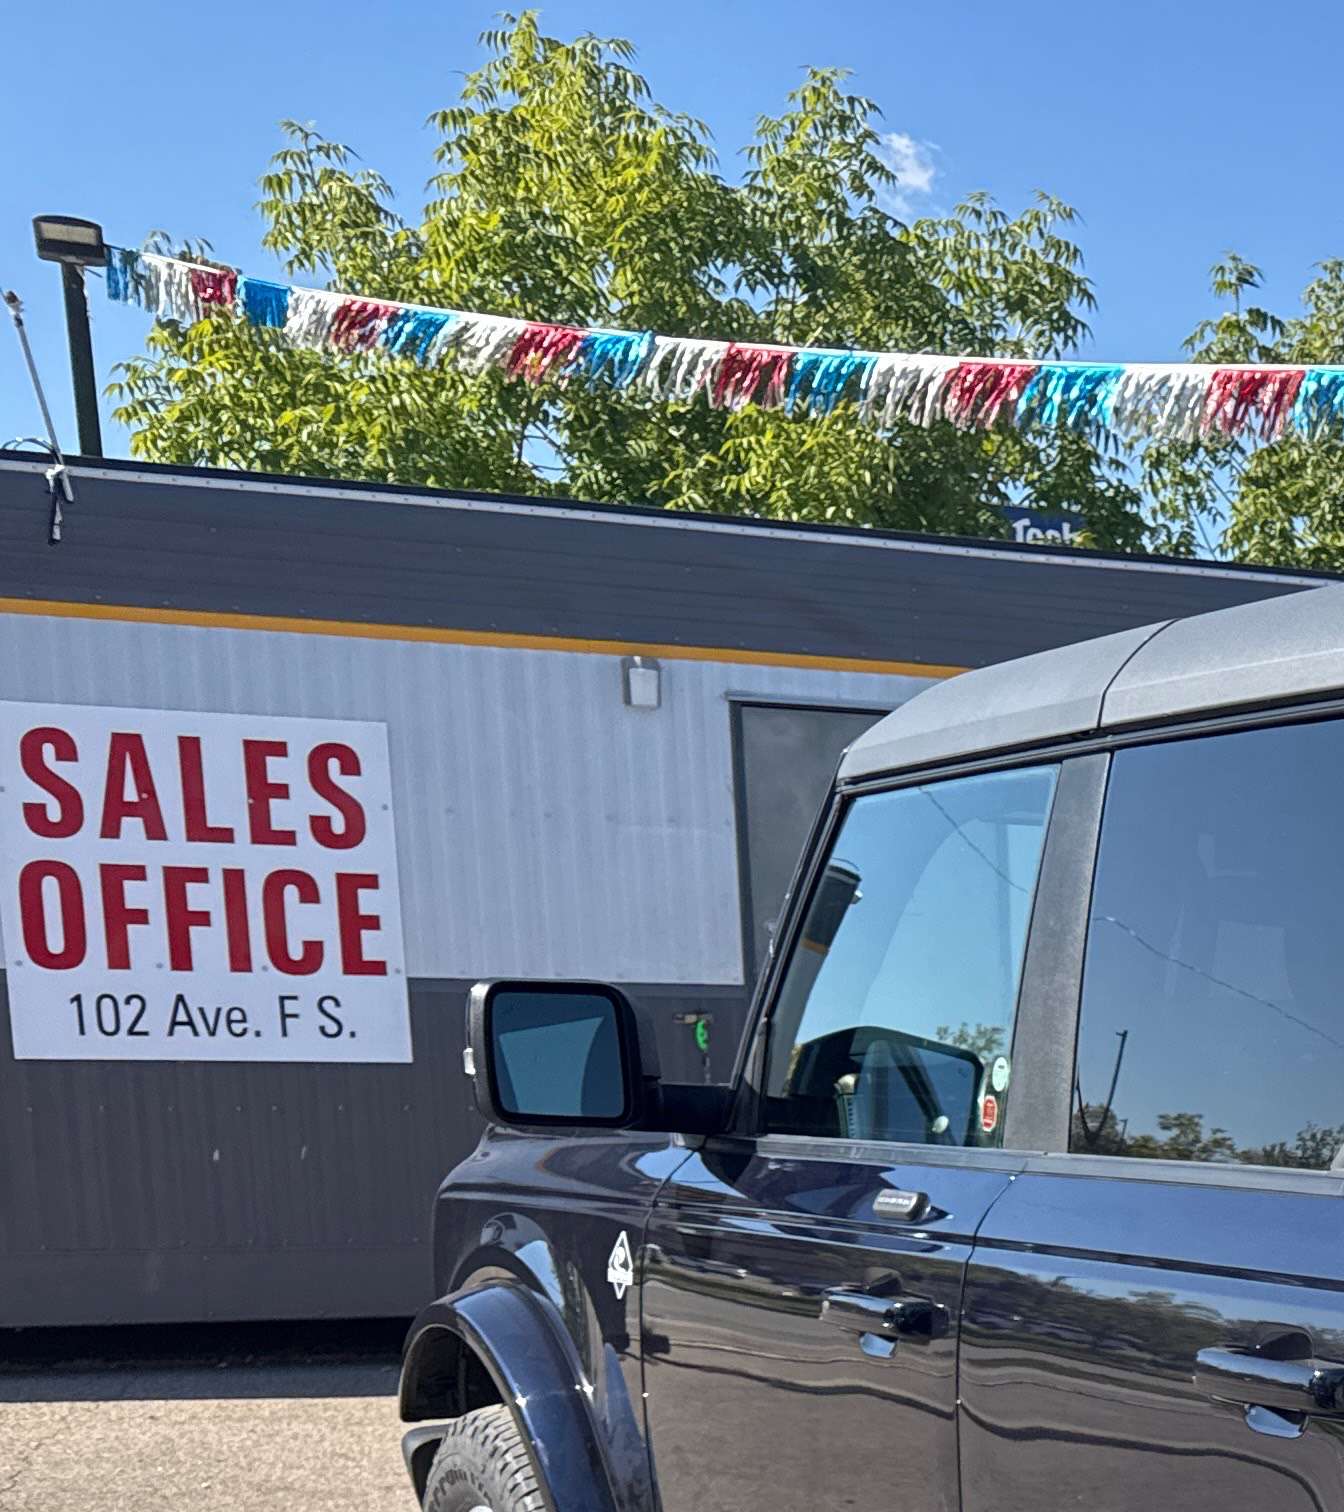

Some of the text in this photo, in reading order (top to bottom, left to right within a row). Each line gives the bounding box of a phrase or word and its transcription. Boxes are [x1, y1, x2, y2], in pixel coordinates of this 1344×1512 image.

[20, 727, 367, 849] SALES
[18, 860, 388, 976] OFFICE
[69, 994, 357, 1038] 102 Ave. F S.
